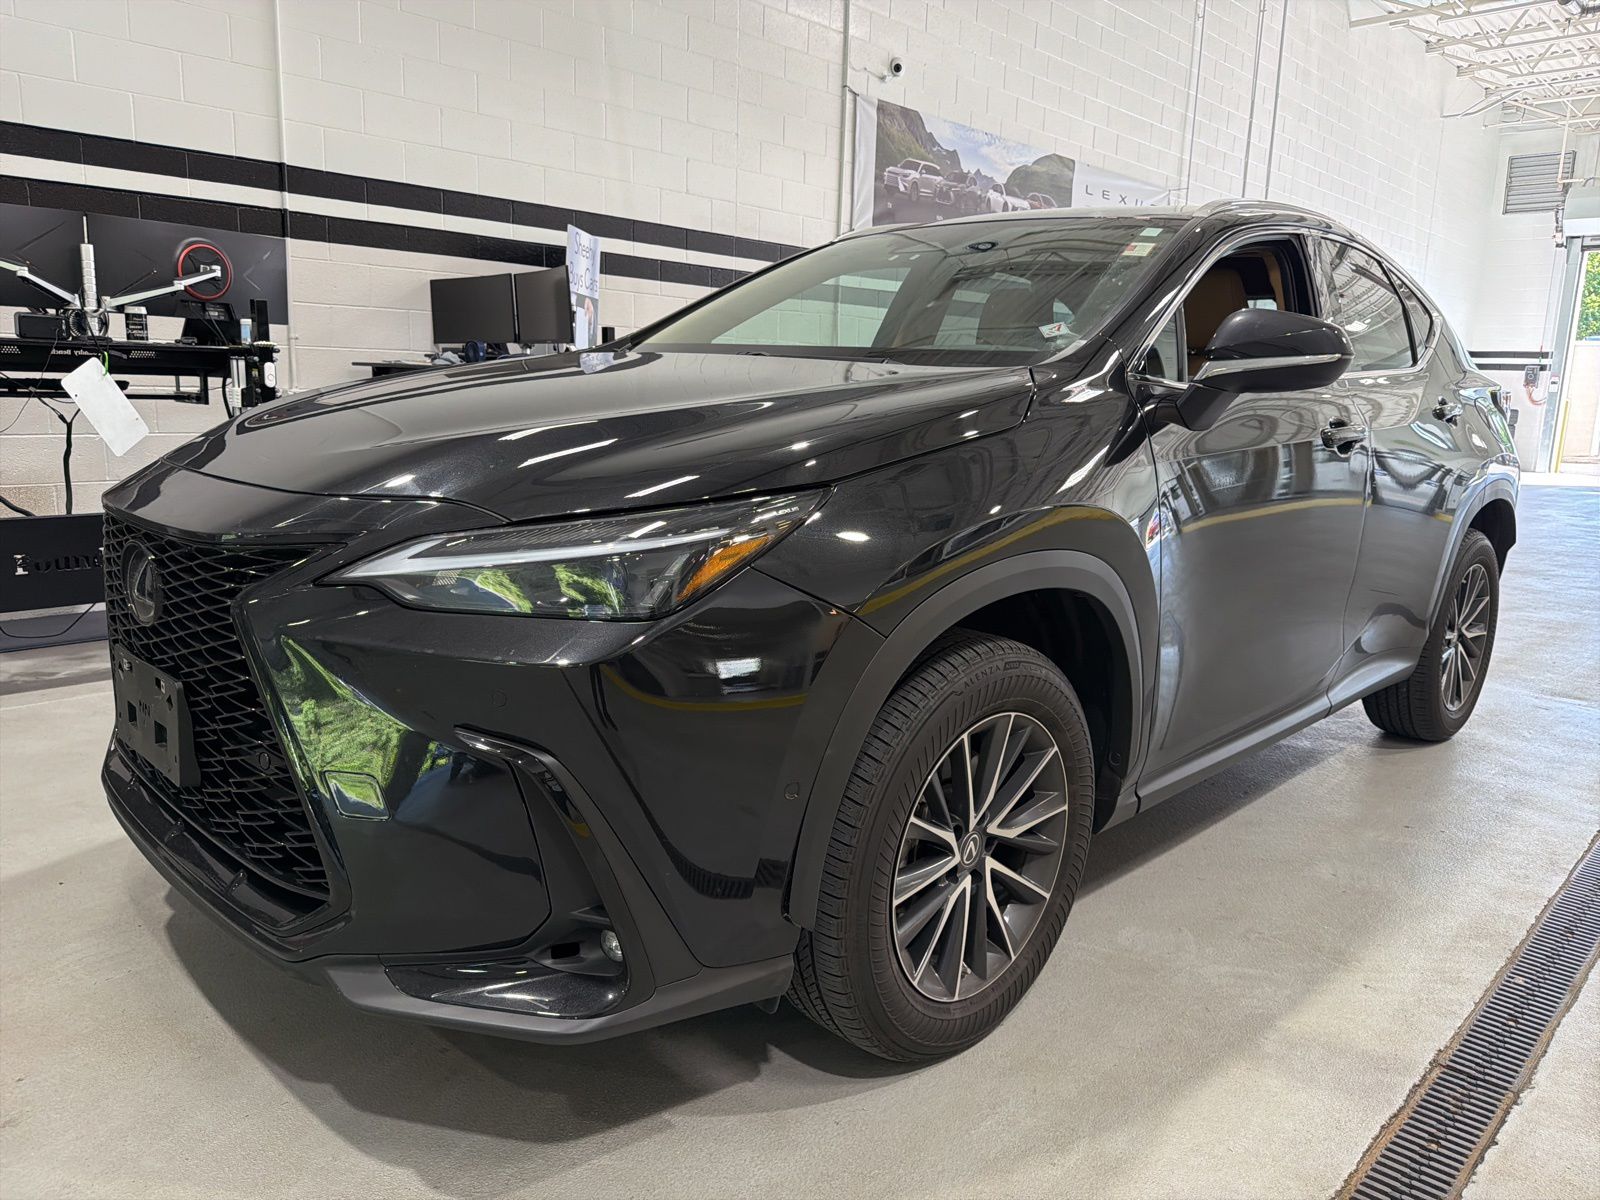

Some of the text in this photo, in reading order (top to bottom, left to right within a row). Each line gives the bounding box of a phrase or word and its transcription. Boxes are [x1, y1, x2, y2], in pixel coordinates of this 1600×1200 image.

[1085, 184, 1158, 207] LEXU
[585, 267, 598, 292] Cars
[963, 664, 1001, 688] ALENZA
